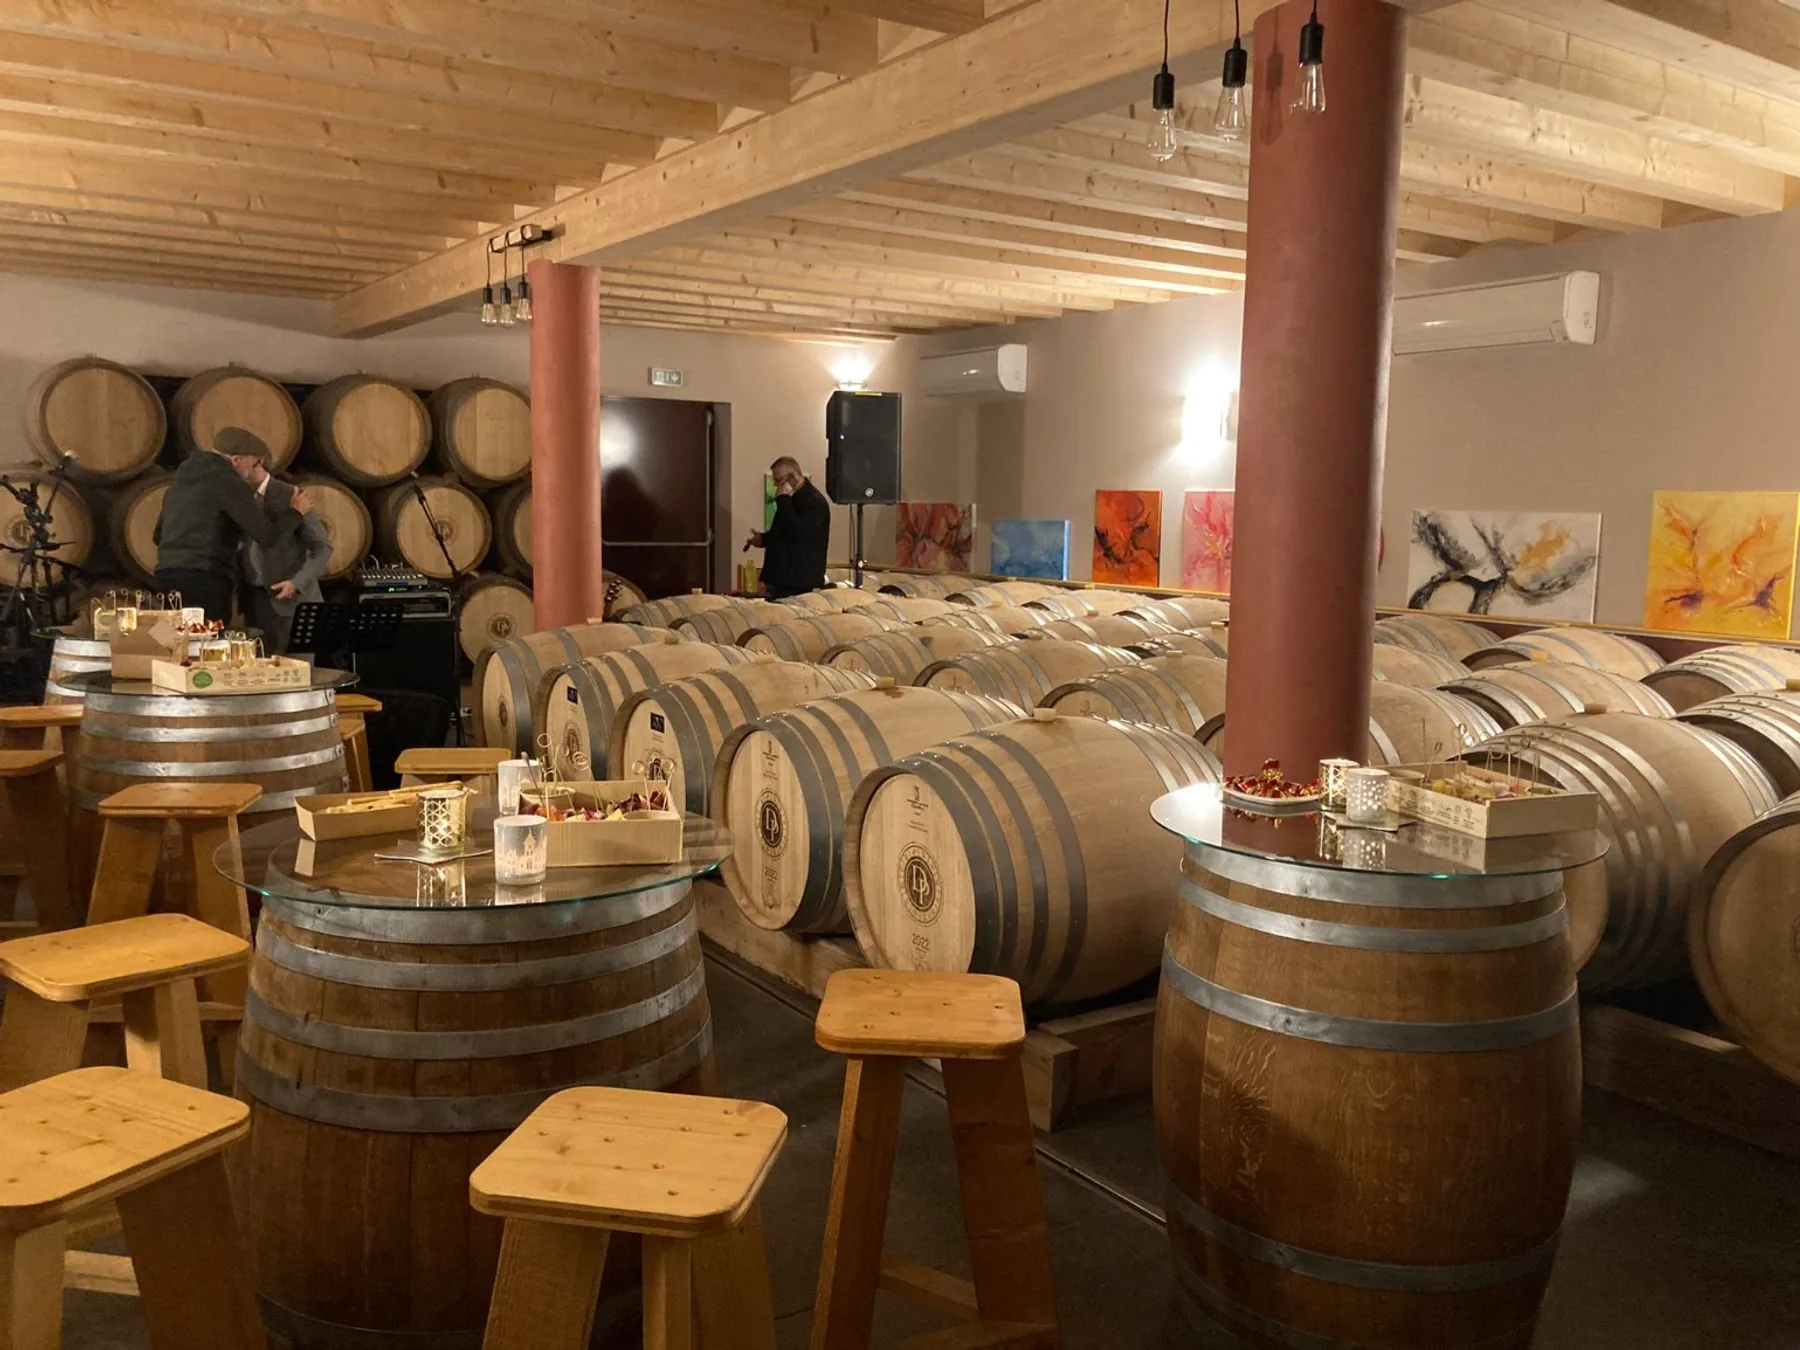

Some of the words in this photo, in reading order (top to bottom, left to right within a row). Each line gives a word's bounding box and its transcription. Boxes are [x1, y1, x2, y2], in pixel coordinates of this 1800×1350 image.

[765, 807, 779, 842] DP
[911, 863, 930, 906] DP
[912, 933, 930, 949] 2022
